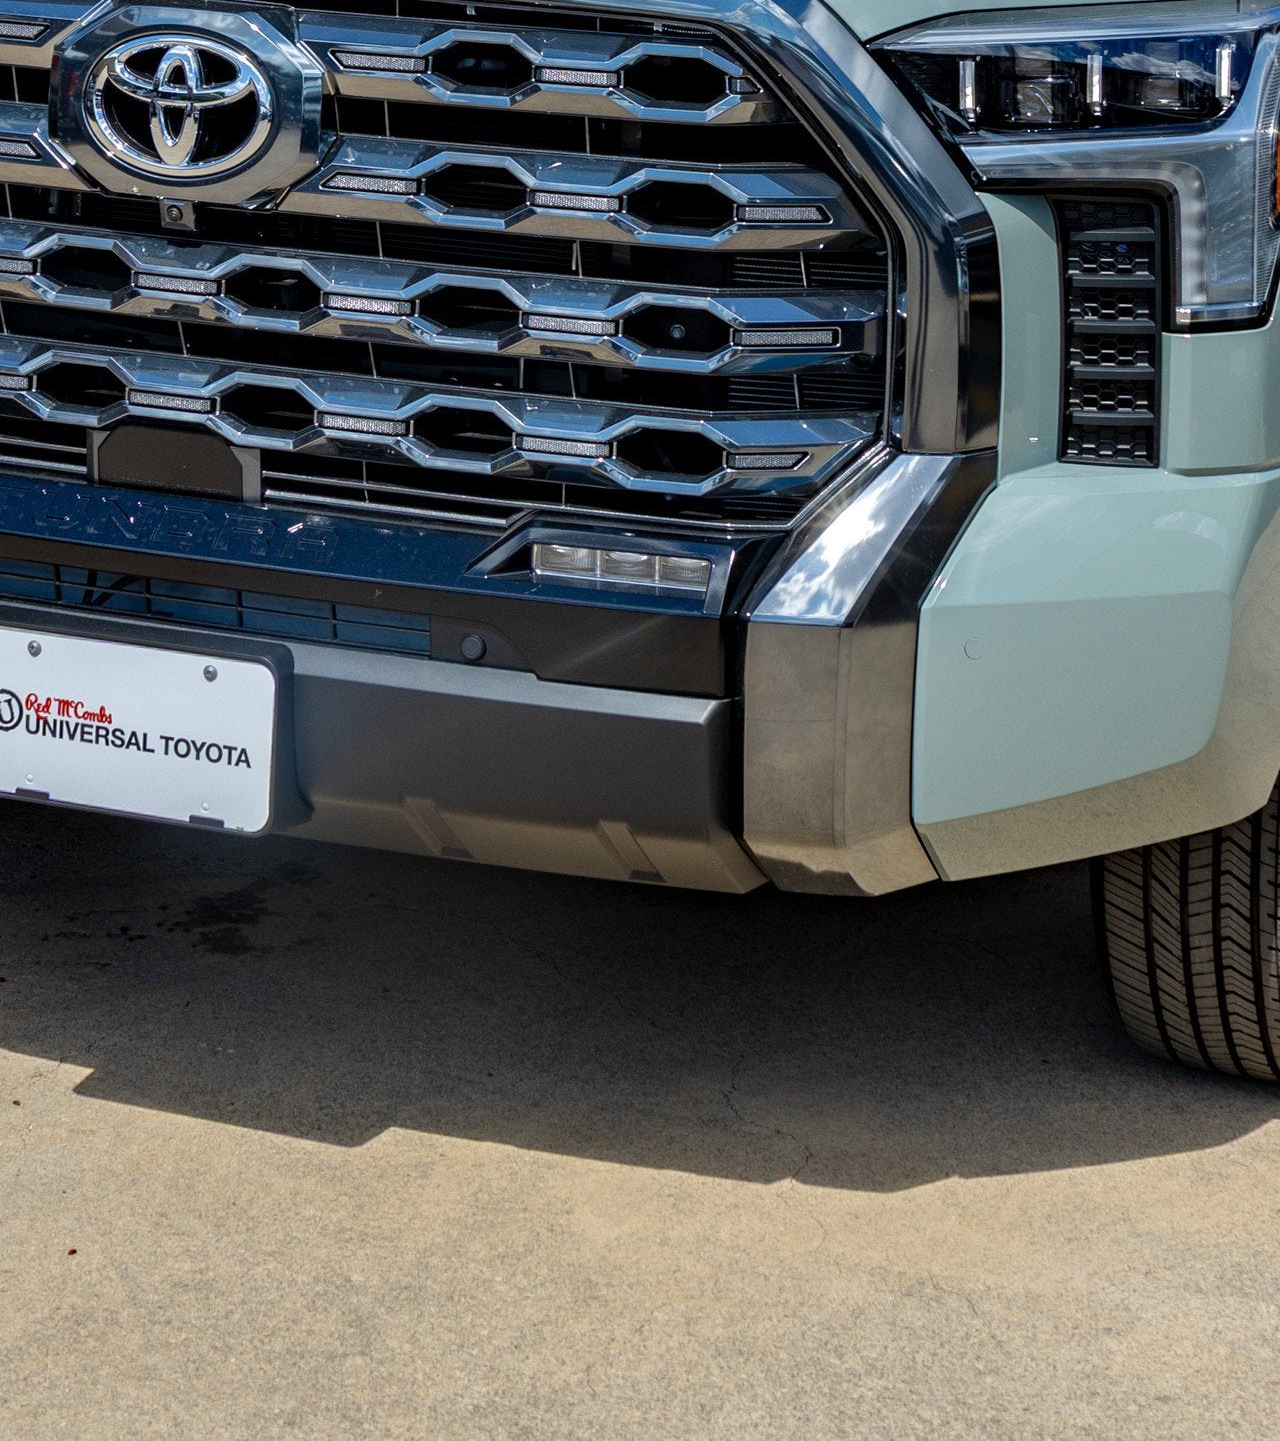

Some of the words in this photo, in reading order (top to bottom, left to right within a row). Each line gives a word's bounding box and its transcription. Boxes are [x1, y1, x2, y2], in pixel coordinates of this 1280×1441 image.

[25, 692, 52, 721] Red
[54, 697, 113, 725] McCombs
[25, 714, 155, 753] UNIVERSAL
[159, 735, 252, 769] TOYOTA
